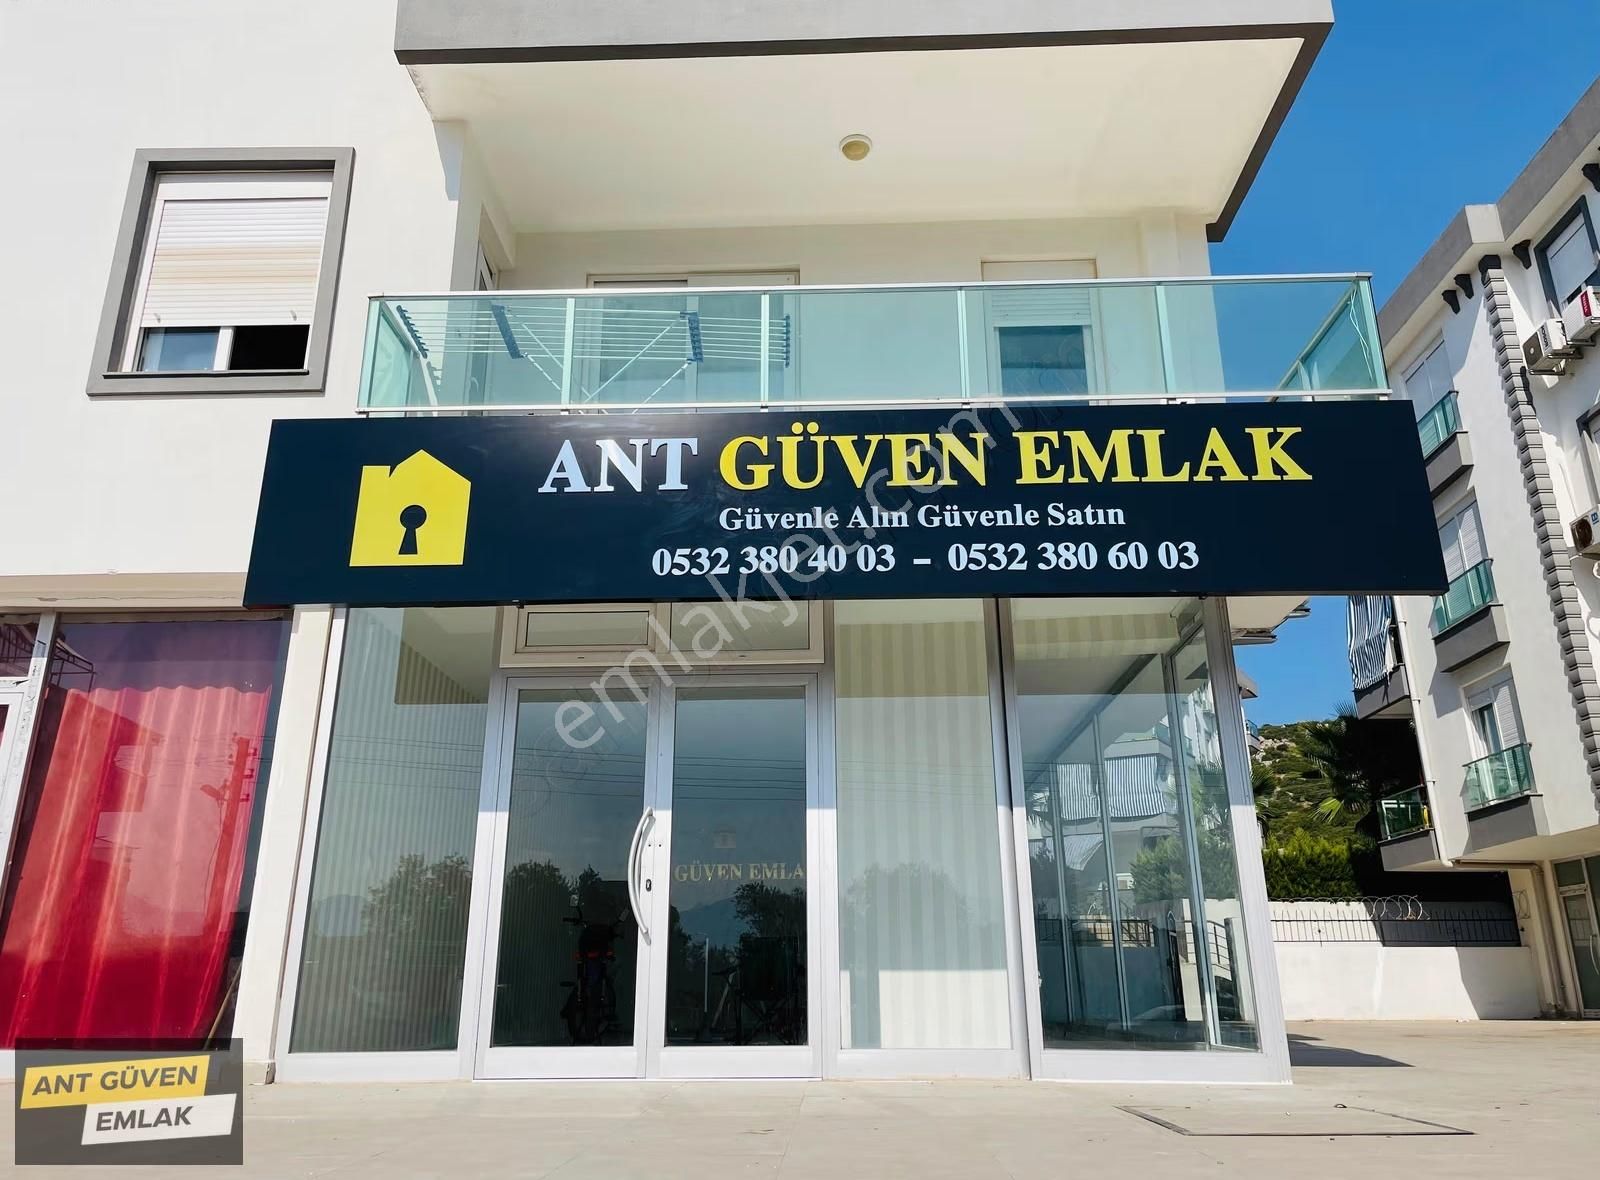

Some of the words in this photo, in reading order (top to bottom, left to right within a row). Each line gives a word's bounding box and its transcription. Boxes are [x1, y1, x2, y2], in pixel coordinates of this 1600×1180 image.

[538, 437, 698, 493] ANT
[719, 421, 988, 491] GÜVEN
[1013, 427, 1312, 485] EMLAK
[719, 506, 839, 531] Güvenle
[847, 505, 909, 528] Alın
[918, 503, 1039, 527] Güvenle
[1048, 502, 1126, 526] Satın
[652, 547, 730, 577] 0532
[739, 546, 798, 575] 380
[807, 544, 847, 573] 40
[856, 543, 896, 572] 03
[948, 542, 1028, 571] 0532
[1037, 541, 1098, 571] 380
[1108, 541, 1149, 570] 60
[1158, 541, 1200, 570] 03
[674, 860, 743, 882] GÜVEN
